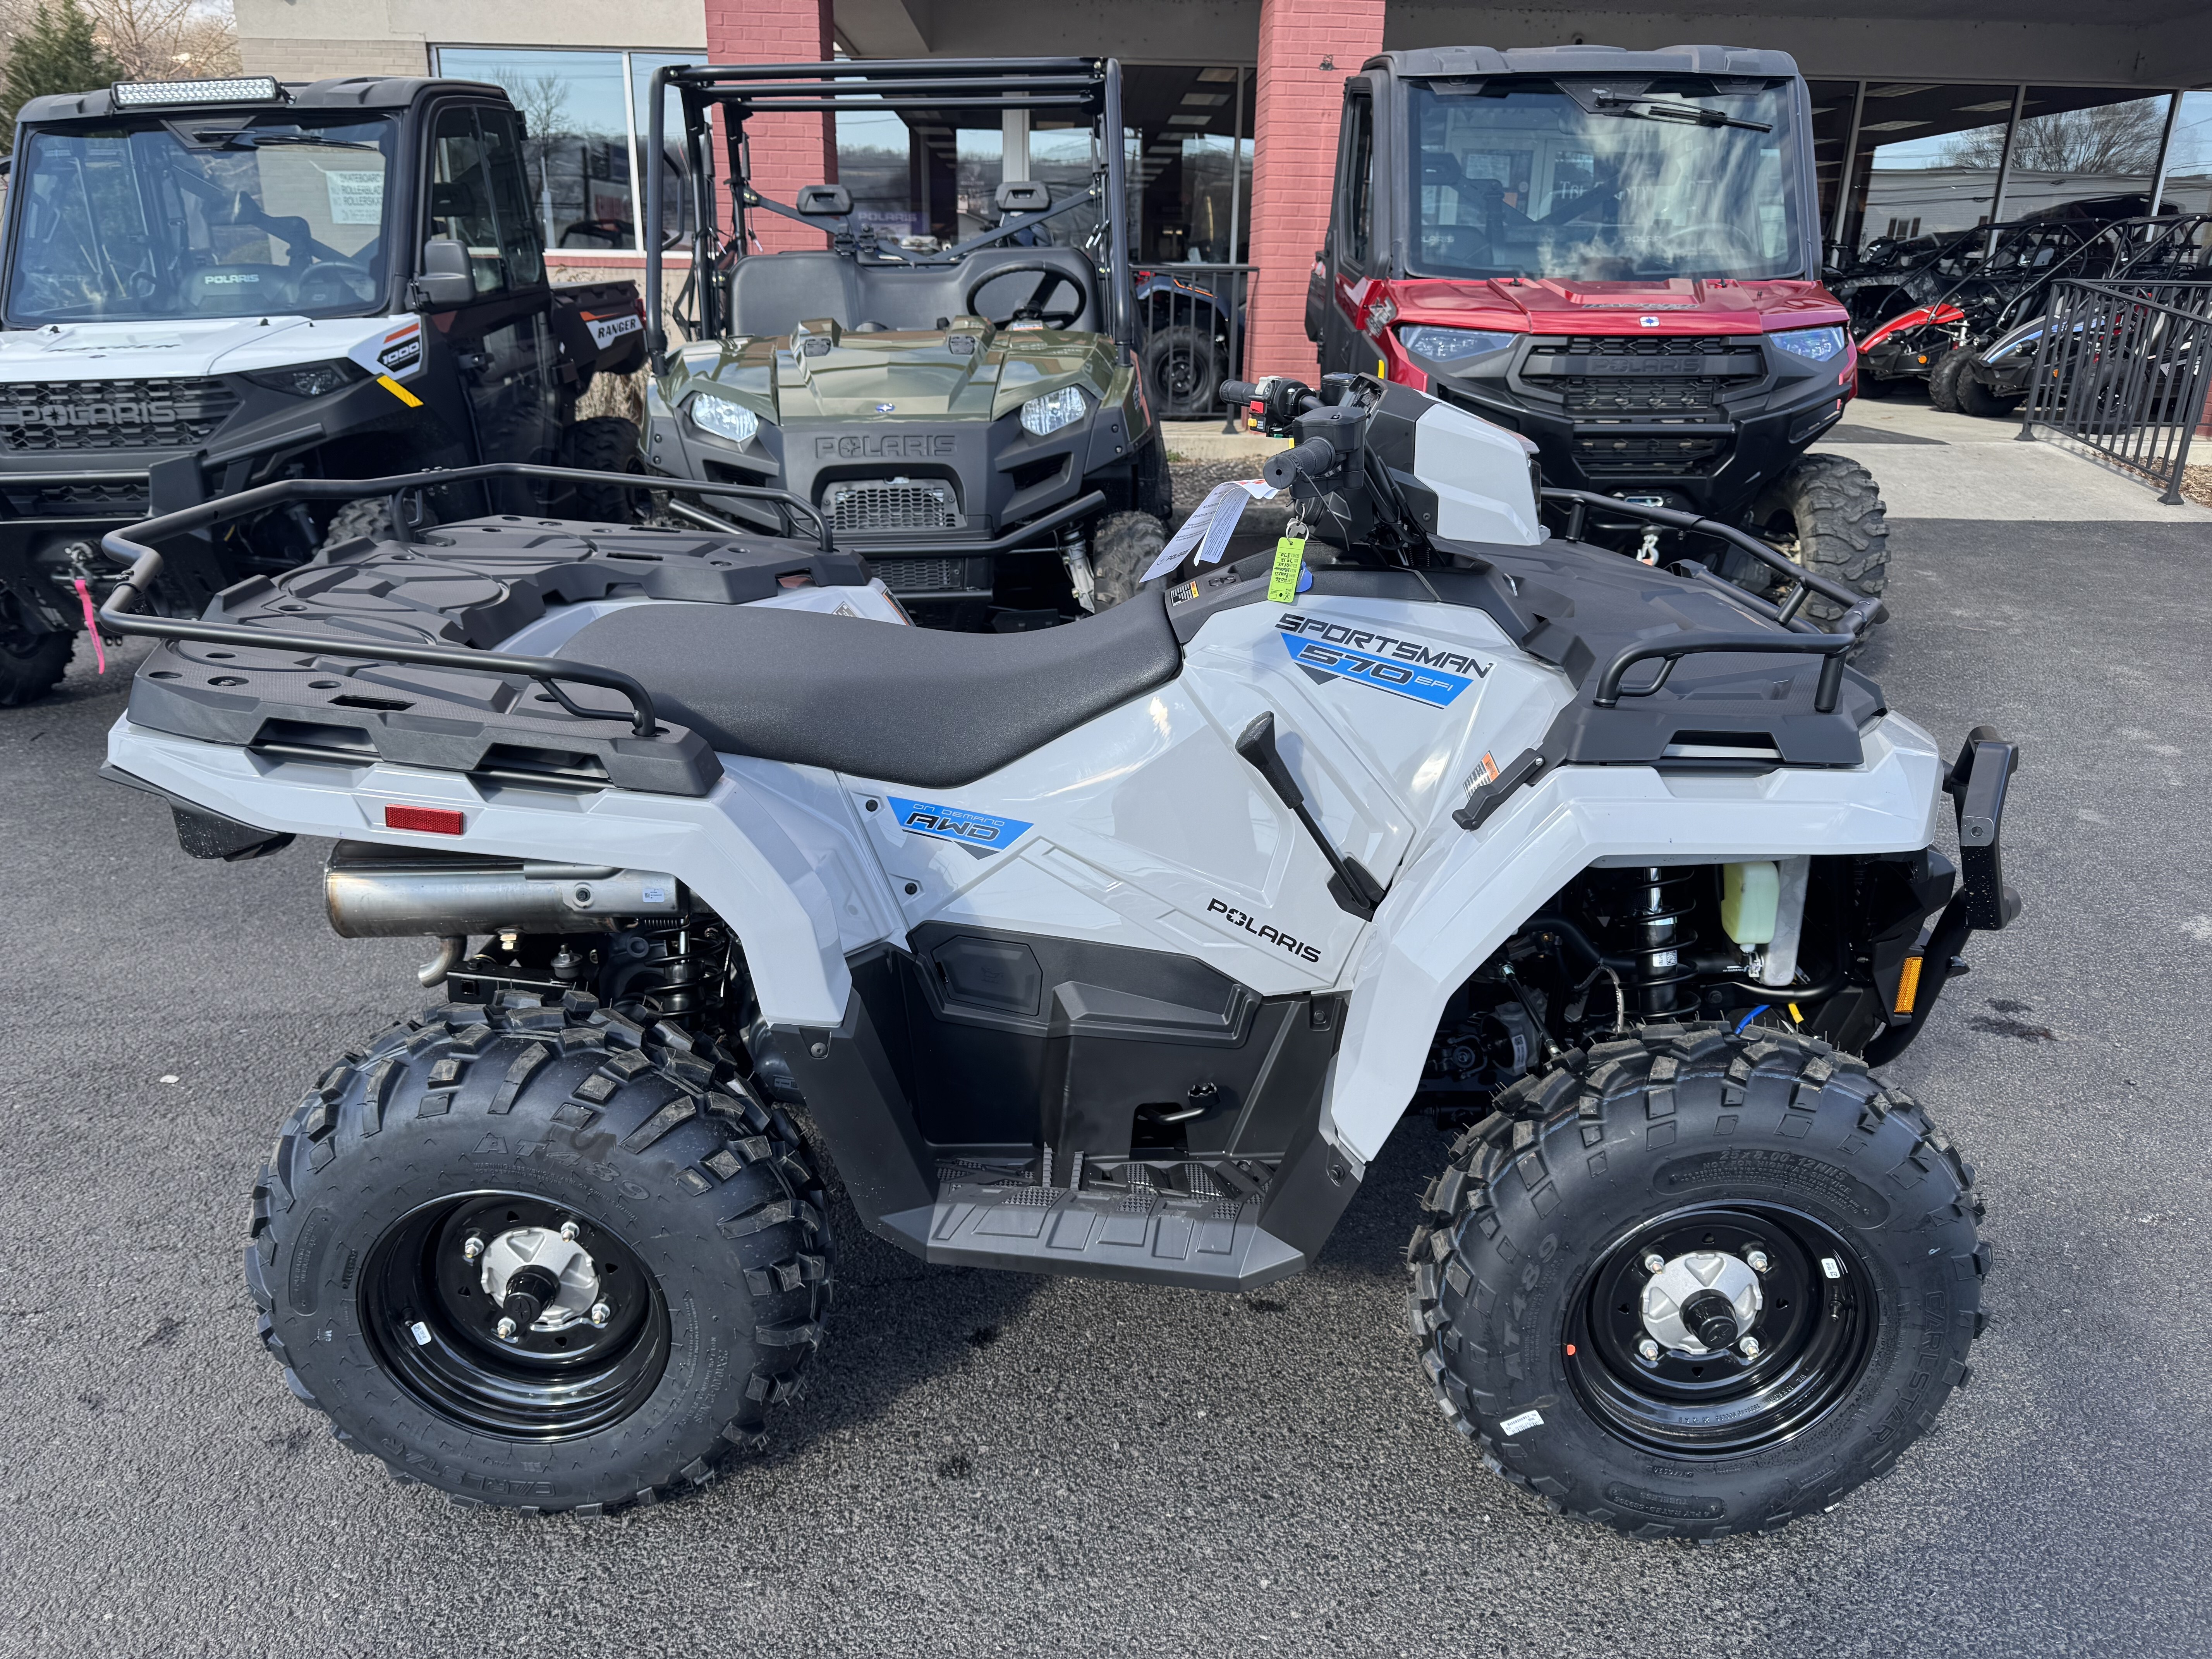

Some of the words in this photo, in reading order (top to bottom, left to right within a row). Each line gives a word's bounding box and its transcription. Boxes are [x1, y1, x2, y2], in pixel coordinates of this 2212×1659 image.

[858, 212, 917, 222] POLARIS
[204, 274, 259, 284] POLARIS
[598, 319, 636, 338] RANGER
[382, 341, 419, 364] 1000
[1591, 359, 1700, 373] POLARIS
[17, 401, 177, 426] POLARIS
[815, 435, 957, 459] POLARIS
[1275, 613, 1493, 678] SPORTSMAN
[1297, 643, 1414, 684] 570
[1414, 676, 1454, 691] EFI
[904, 811, 1000, 841] AWD
[913, 804, 935, 812] ON
[941, 808, 1005, 826] DEMAND
[1207, 898, 1321, 963] POLARIS
[1757, 1161, 1808, 1175] HIGHWAY
[1810, 1171, 1853, 1194] SERVICE
[1814, 1162, 1848, 1181] NHS
[694, 1404, 711, 1423] NHS
[1640, 1492, 1688, 1504] TUBELESS
